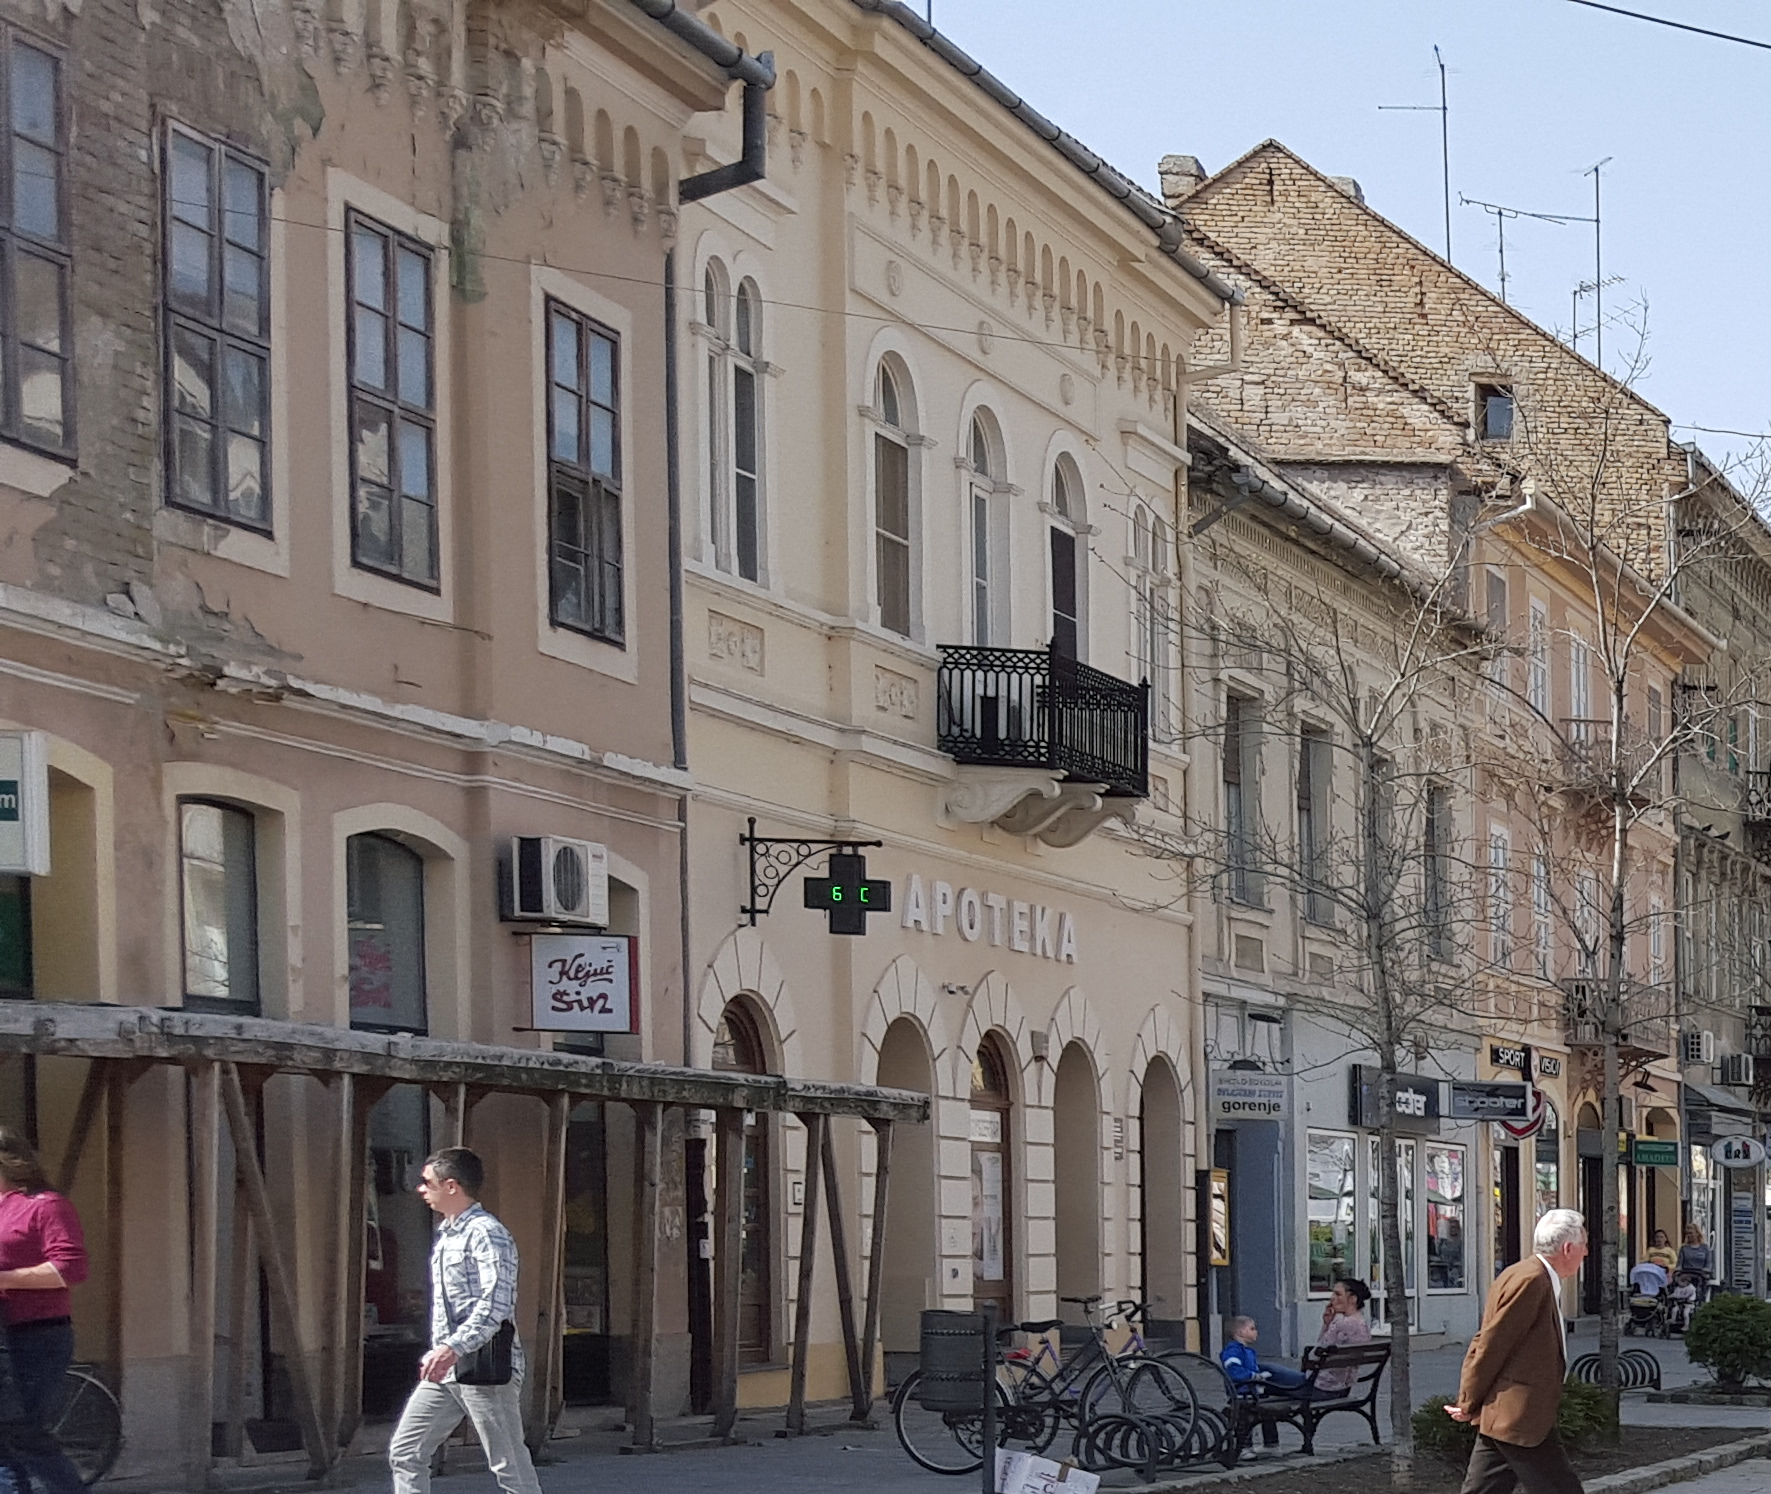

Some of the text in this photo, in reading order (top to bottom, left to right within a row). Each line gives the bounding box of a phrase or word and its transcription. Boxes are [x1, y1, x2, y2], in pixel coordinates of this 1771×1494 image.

[902, 872, 1079, 965] APOTEKA
[1498, 1047, 1526, 1068] SPORT
[1221, 1099, 1281, 1116] gorenje
